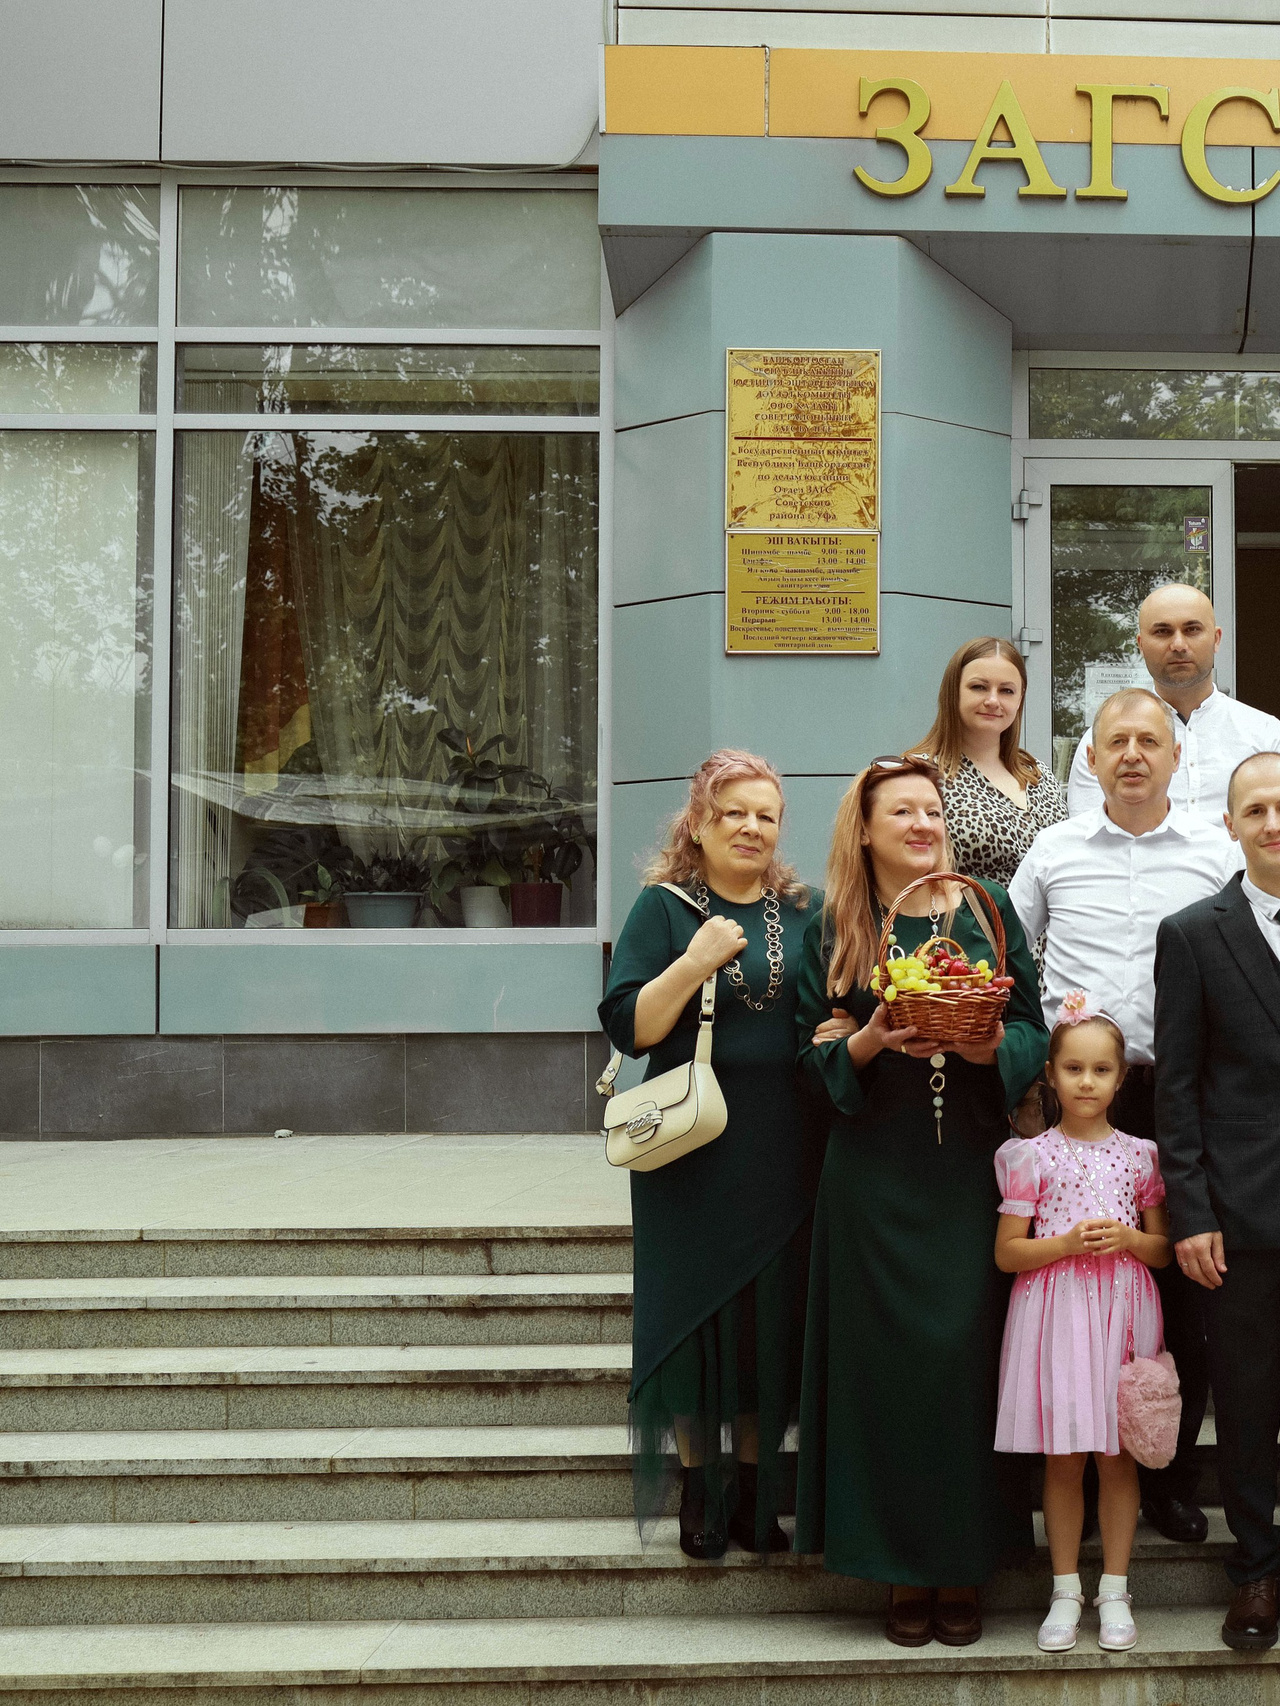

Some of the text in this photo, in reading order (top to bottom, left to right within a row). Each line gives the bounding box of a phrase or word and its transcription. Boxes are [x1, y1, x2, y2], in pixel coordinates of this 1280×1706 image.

[738, 446, 824, 456] Государственный
[736, 459, 794, 469] Республики
[774, 485, 804, 494] Отдел
[769, 512, 804, 522] района
[764, 536, 784, 545] ЭШ
[756, 596, 852, 605] РЕЖИМ РАБОТЫ:
[782, 608, 810, 616] суббота
